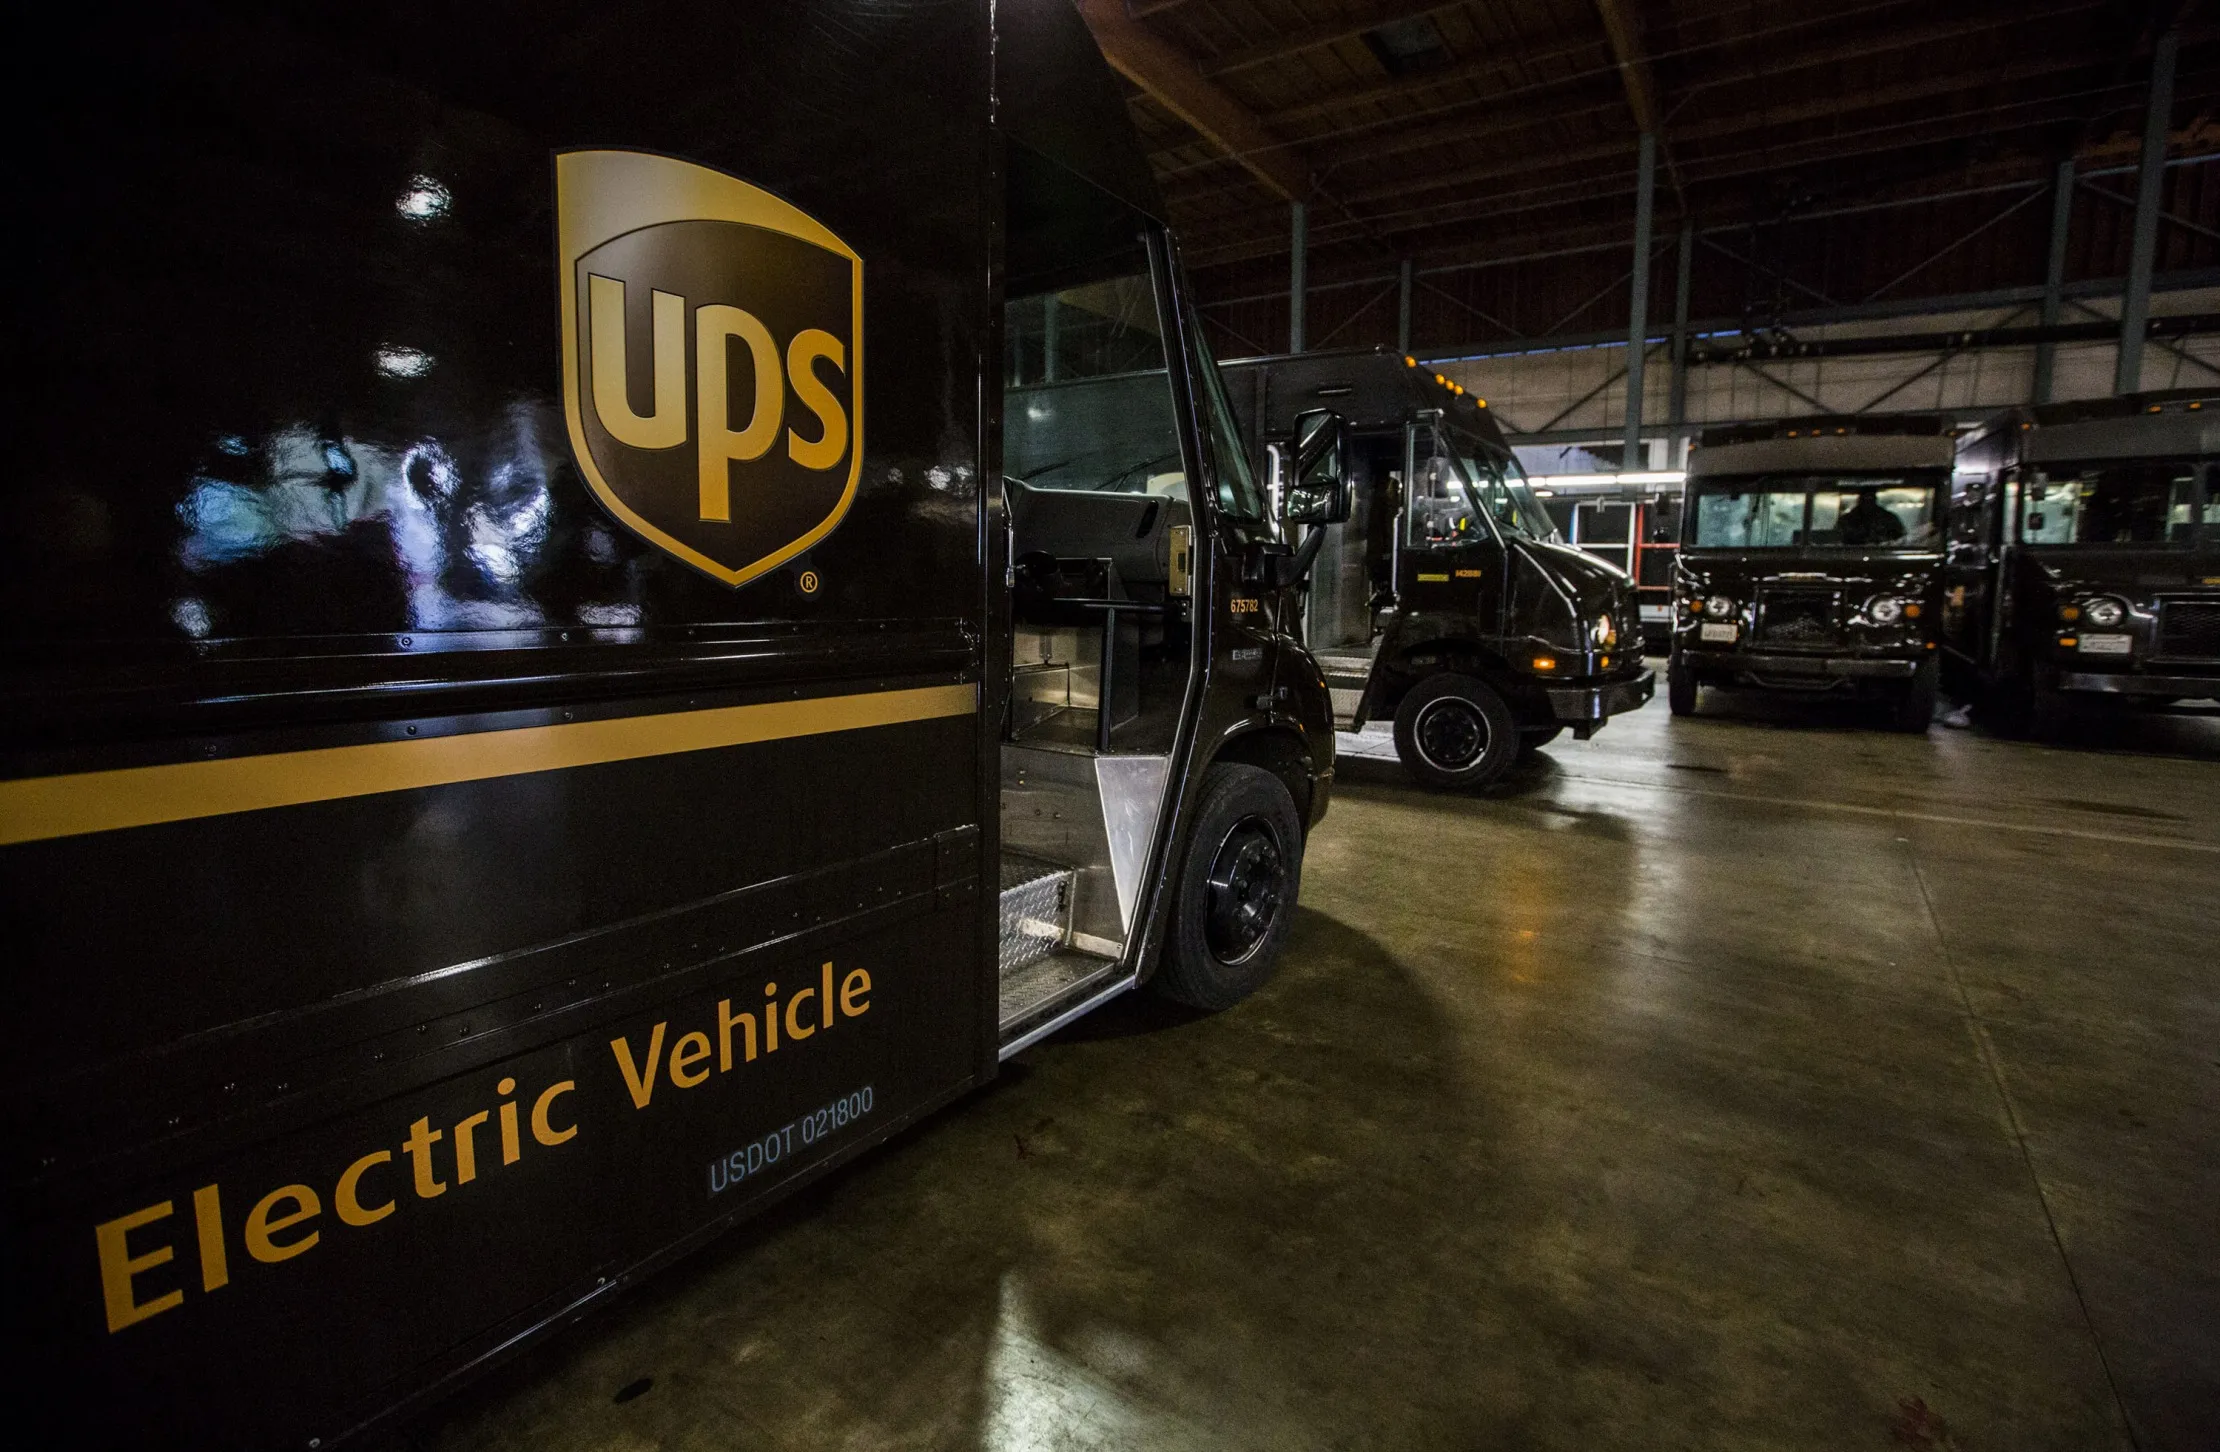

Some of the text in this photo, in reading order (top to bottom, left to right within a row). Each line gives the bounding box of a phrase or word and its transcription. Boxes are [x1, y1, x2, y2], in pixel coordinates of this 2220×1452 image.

[1230, 598, 1260, 614] 675782
[95, 960, 874, 1334] Electric Vehicle
[710, 1085, 874, 1193] USDOT 021800
